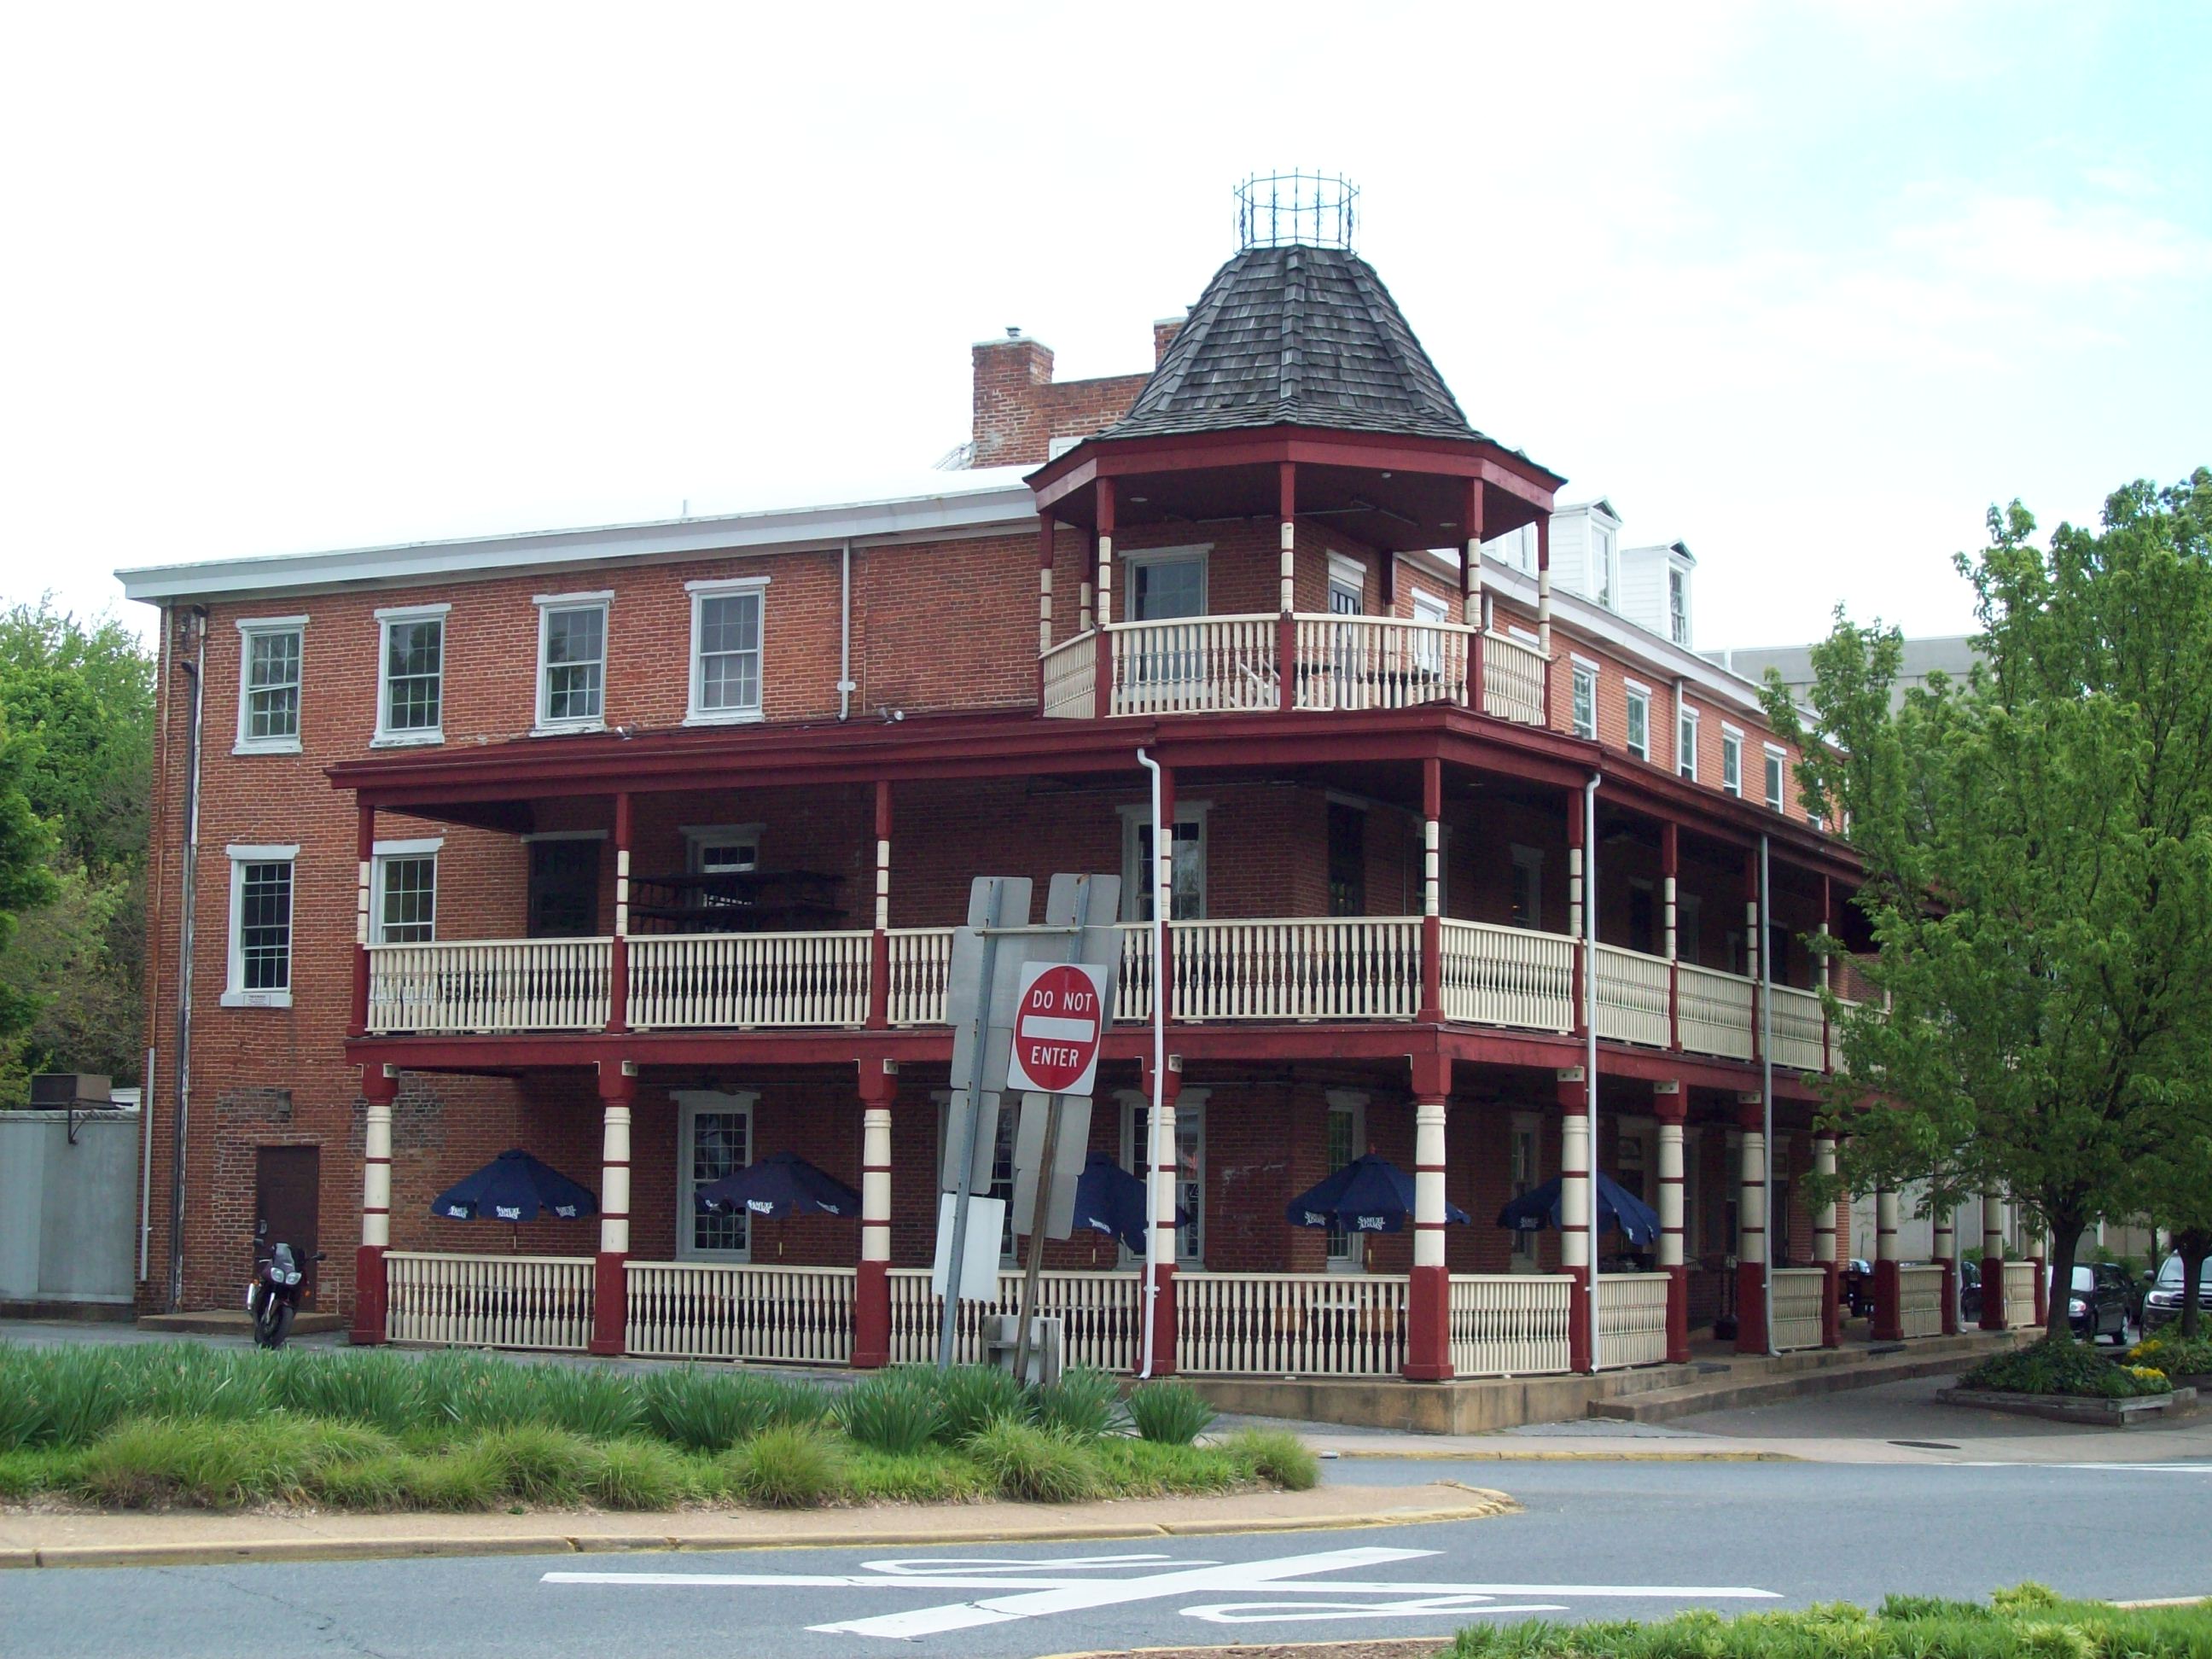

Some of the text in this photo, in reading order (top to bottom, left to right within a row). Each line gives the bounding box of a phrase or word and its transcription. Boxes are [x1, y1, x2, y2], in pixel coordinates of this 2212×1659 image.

[1033, 989, 1093, 1012] DO NOT
[1031, 1045, 1079, 1068] ENTER
[1357, 1215, 1385, 1225] SAMUEL
[1358, 1221, 1382, 1231] ADAMS
